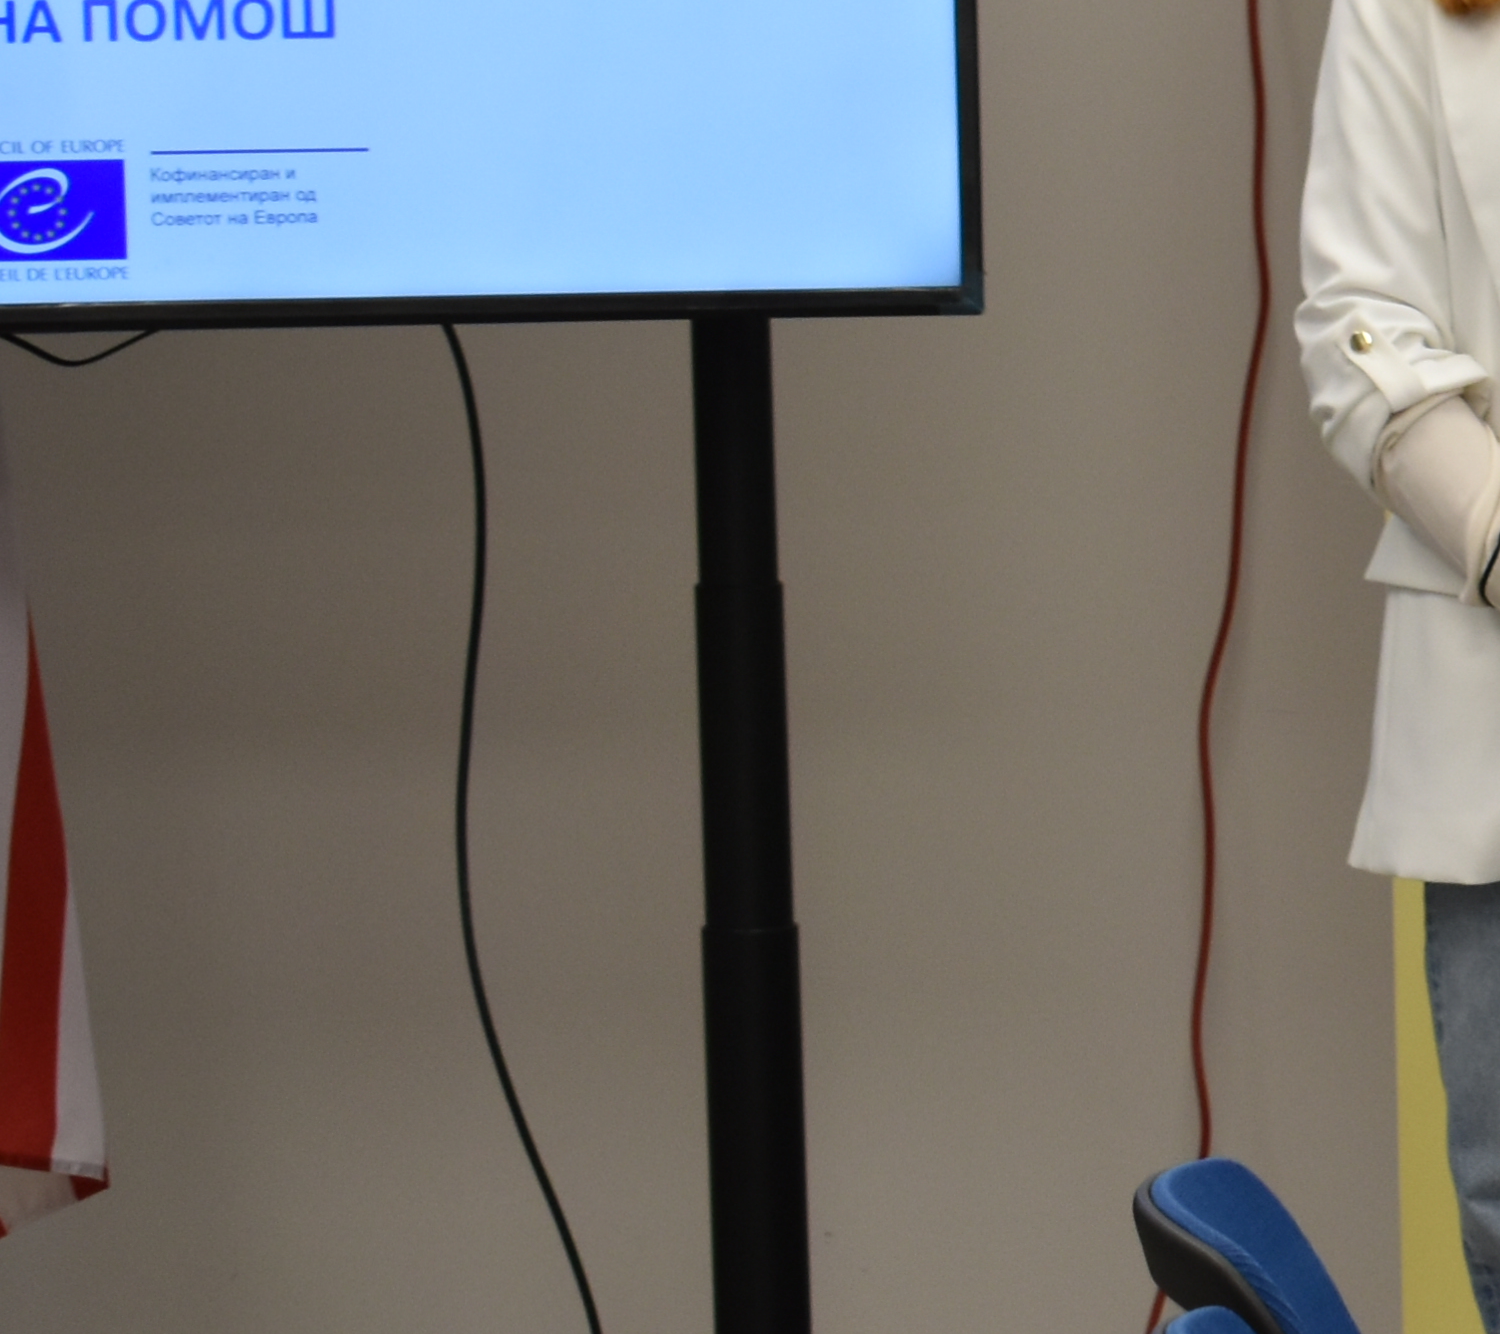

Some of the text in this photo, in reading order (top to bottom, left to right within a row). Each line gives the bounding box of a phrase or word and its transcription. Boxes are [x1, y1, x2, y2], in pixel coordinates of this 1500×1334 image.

[31, 140, 51, 154] OF
[62, 139, 125, 153] EUROPE
[151, 168, 295, 184] Кофинансиран и
[151, 190, 317, 205] имплементиран од
[151, 210, 318, 227] Советот на Европа
